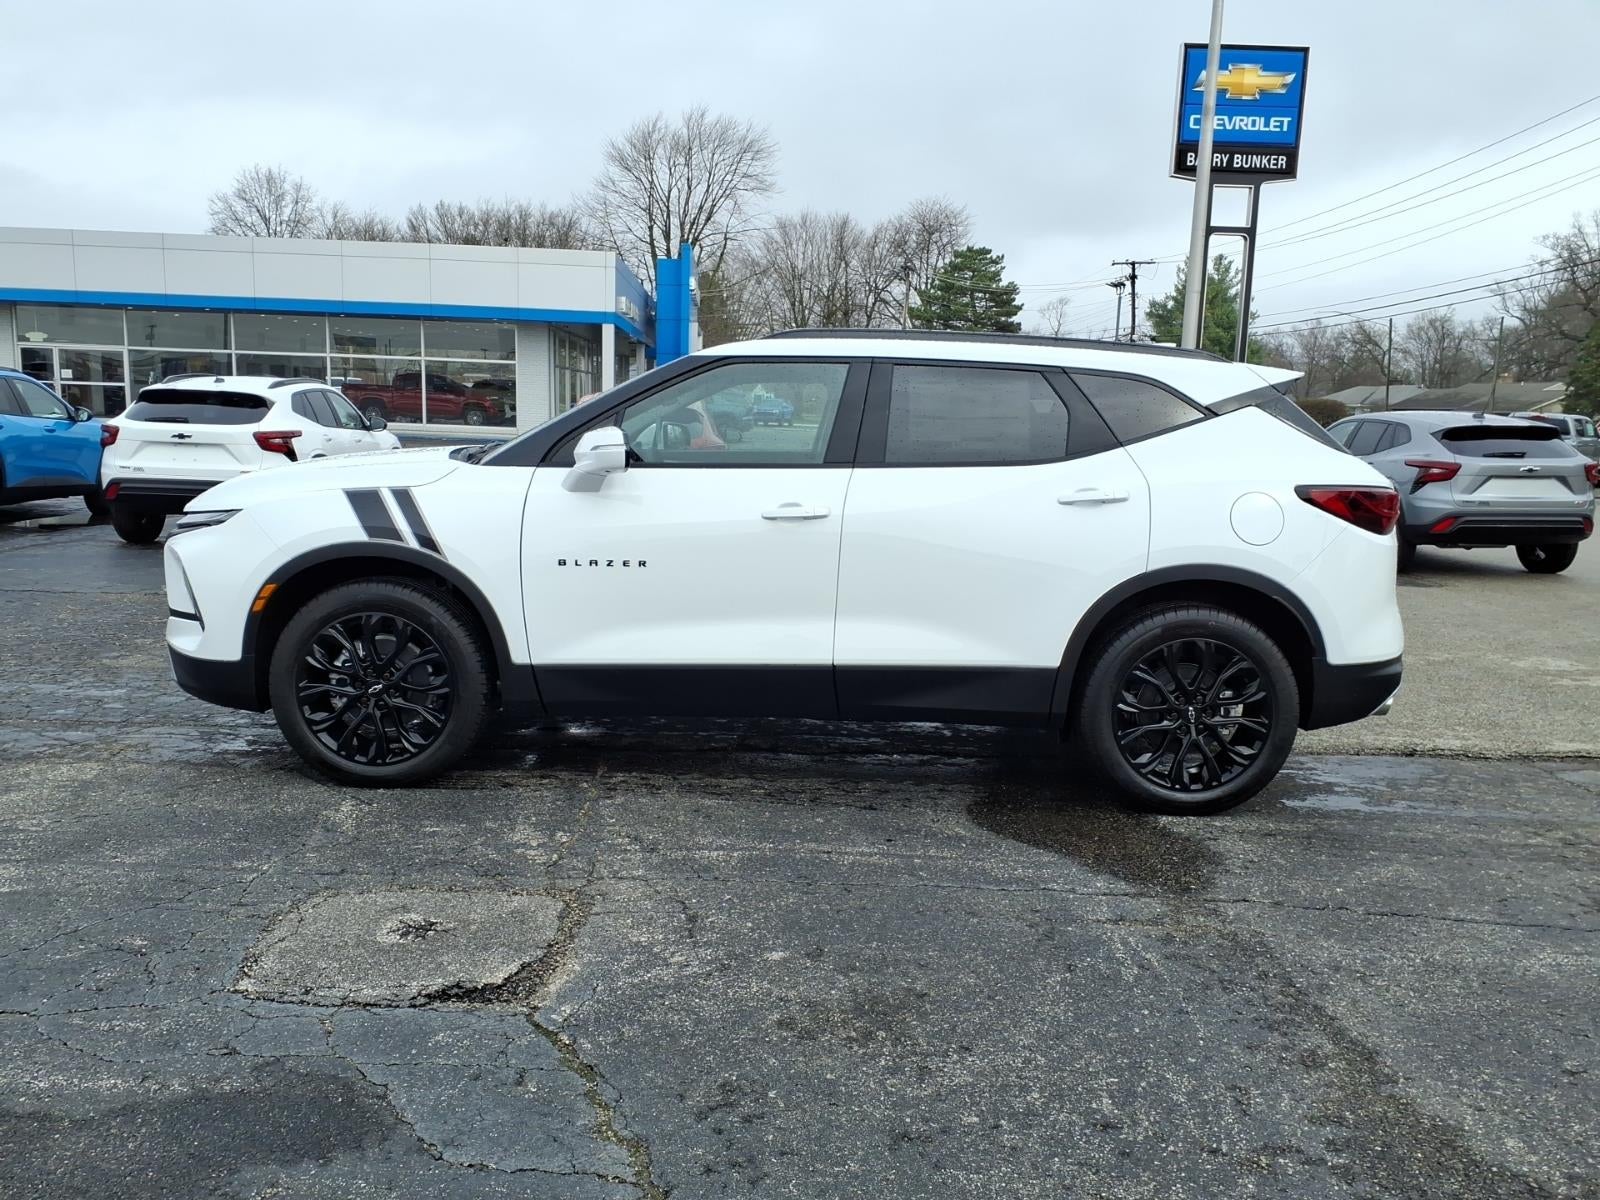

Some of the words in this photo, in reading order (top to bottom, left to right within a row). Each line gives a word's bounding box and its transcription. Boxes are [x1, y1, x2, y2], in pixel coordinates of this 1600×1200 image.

[1189, 114, 1292, 132] CEVROLET
[1186, 152, 1230, 168] BRY
[1233, 154, 1287, 169] BUNKER
[557, 558, 648, 568] BLAZER
